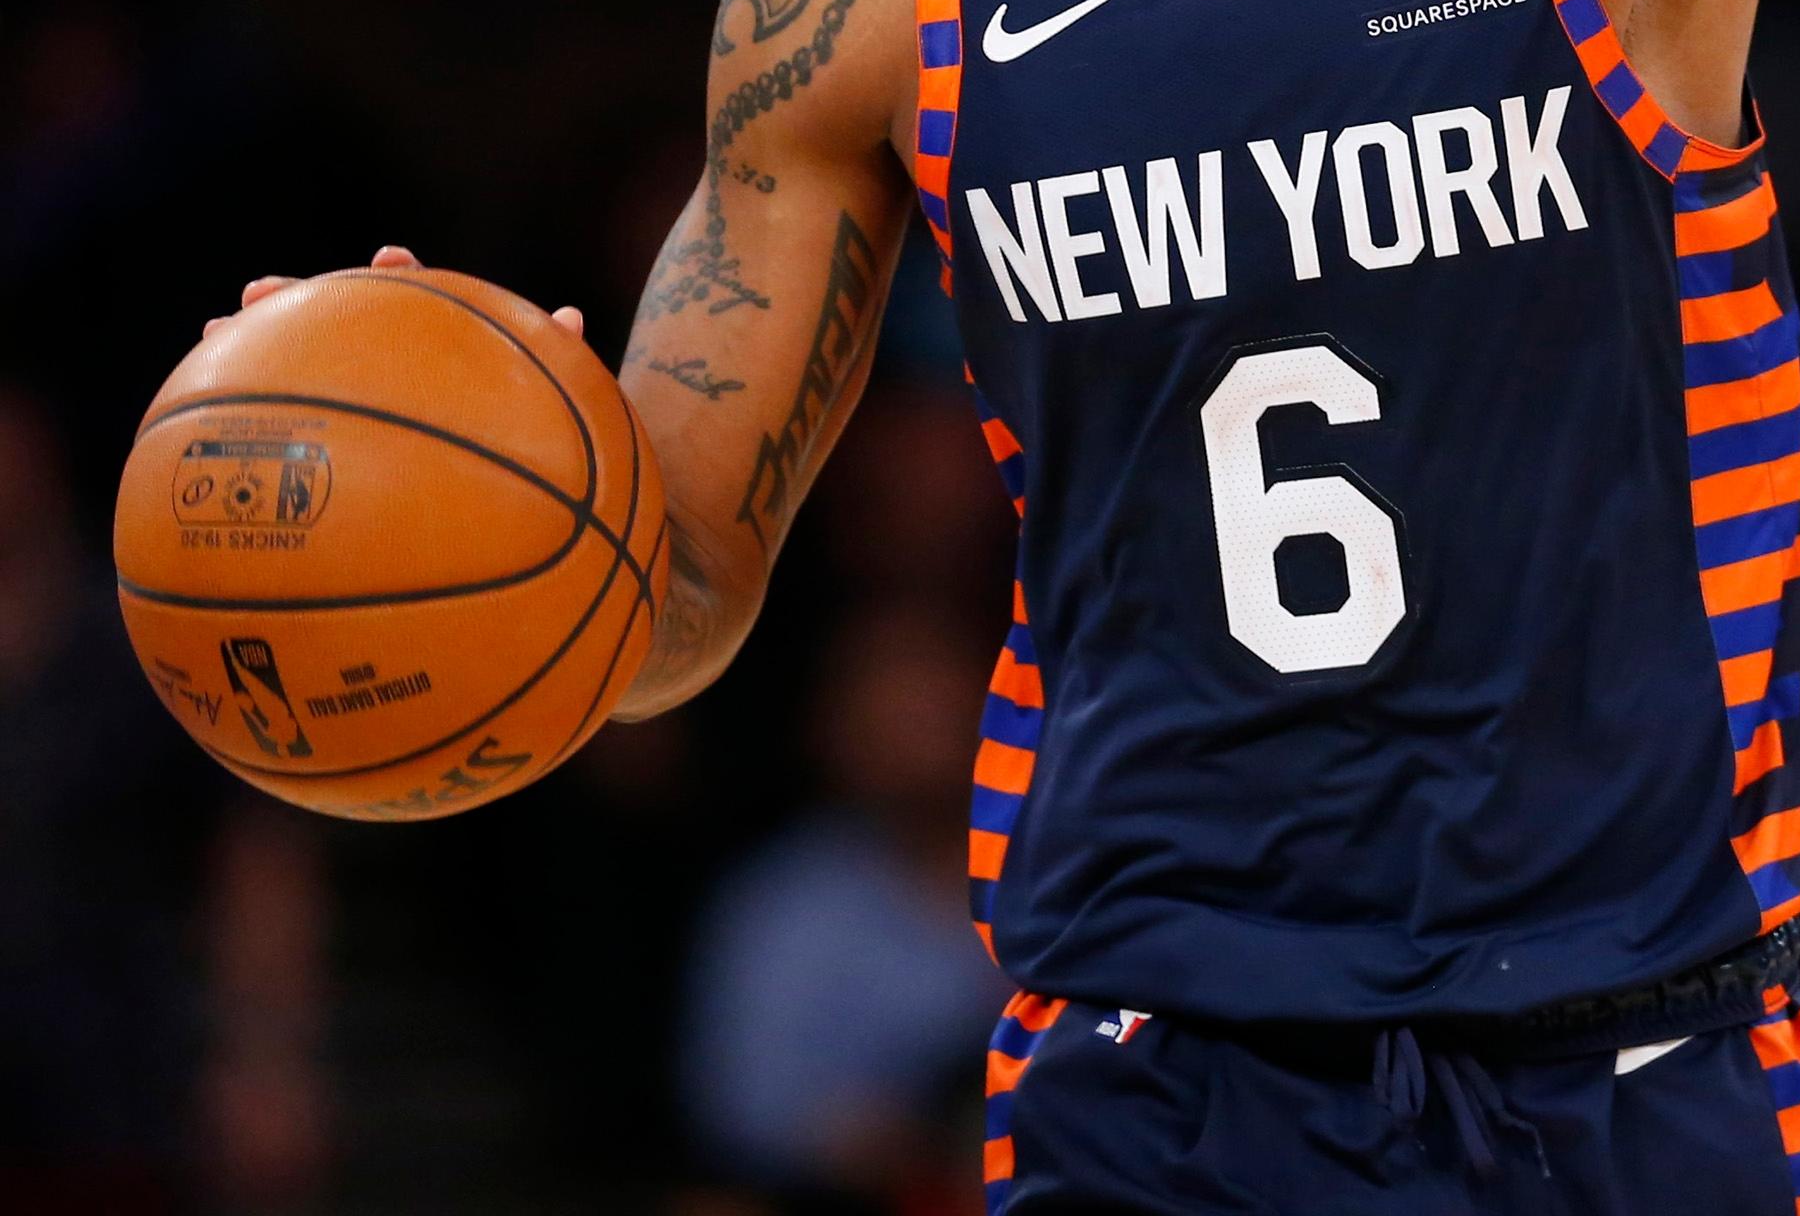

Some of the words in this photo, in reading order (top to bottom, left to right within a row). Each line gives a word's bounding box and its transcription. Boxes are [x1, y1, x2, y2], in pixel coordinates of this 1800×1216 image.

[965, 150, 1227, 322] NEW
[1247, 85, 1588, 281] YORK
[1200, 345, 1407, 674] 6
[228, 530, 306, 550] KNICKS
[238, 643, 268, 667] NBA
[338, 686, 376, 714] GAME
[374, 671, 432, 706] OFFICIAL
[306, 695, 339, 720] BALL
